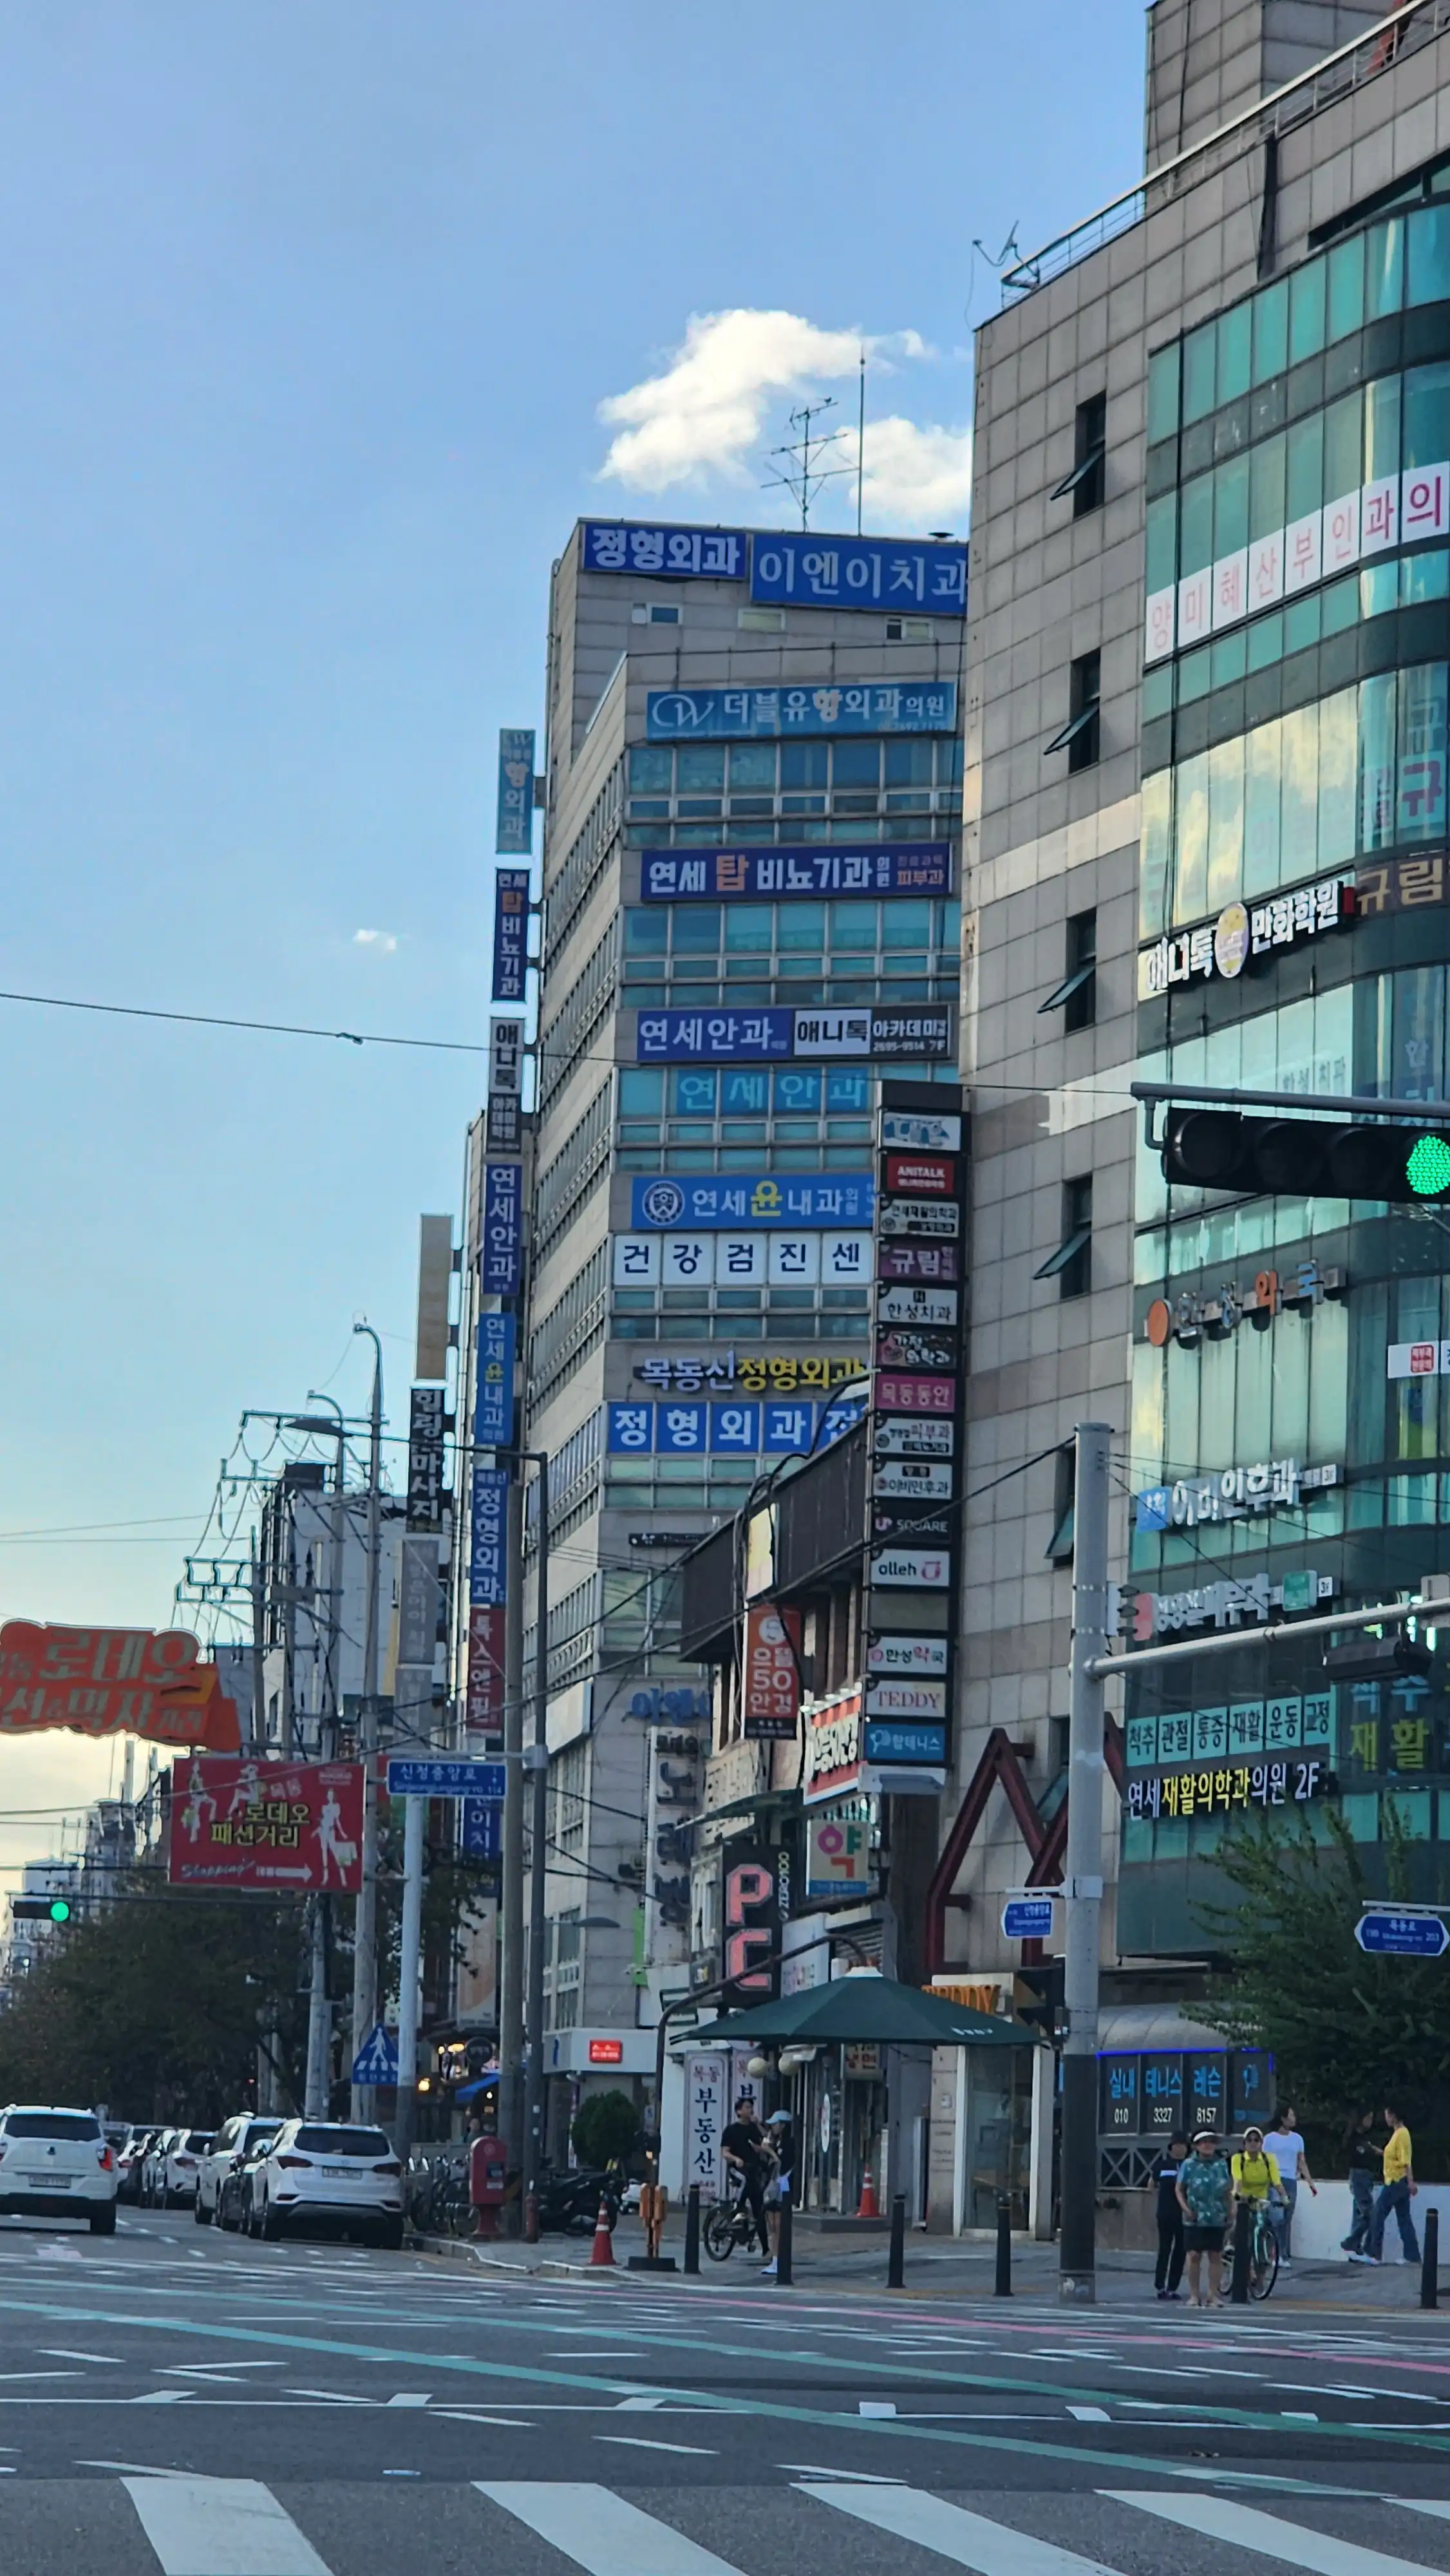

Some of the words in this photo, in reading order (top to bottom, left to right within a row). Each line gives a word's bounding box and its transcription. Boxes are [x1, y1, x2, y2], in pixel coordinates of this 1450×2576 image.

[592, 529, 740, 575] 정형외과
[650, 861, 706, 893] 연세
[717, 855, 749, 891] 탑
[757, 857, 872, 891] 비뇨기과
[897, 869, 944, 886] 피부과
[1357, 858, 1443, 917] 규림
[1251, 877, 1339, 954] 만화학원
[640, 1017, 773, 1051] 연세안과
[797, 1019, 868, 1043] 애니톡
[873, 1019, 937, 1038] 아카데미
[679, 1074, 865, 1123] 연세안과
[898, 1166, 945, 1178] ANITALK
[787, 1188, 842, 1215] 내과
[488, 1168, 517, 1282] 연세안과
[623, 1244, 860, 1274] 건강검진센
[889, 1249, 940, 1275] 규림
[737, 1357, 865, 1390] 정형외과
[881, 1383, 950, 1406] 목동동안
[614, 1410, 806, 1446] 정형외과
[411, 1452, 440, 1520] 마사지
[897, 1519, 948, 1532] SQUARE
[473, 1488, 501, 1603] 정형외과
[879, 1562, 917, 1576] olleh
[39, 1631, 194, 1683] 로데오
[753, 1669, 791, 1690] 50
[749, 1693, 791, 1714] 안경
[875, 1691, 940, 1708] TEDDY
[1162, 1719, 1188, 1753] 관절
[1270, 1705, 1298, 1739] 운동
[1128, 1763, 1286, 1821] 연세재활의학과의원
[1295, 1762, 1319, 1799] 2F
[245, 1801, 310, 1825] 로데오
[211, 1822, 300, 1848] 패션거리
[726, 1864, 773, 1992] PC
[1109, 2067, 1135, 2099] 실내
[1145, 2066, 1182, 2098] 테니스
[1194, 2066, 1221, 2097] 레슨
[694, 2087, 717, 2174] 부동산
[1115, 2108, 1129, 2123] 010
[1153, 2107, 1172, 2123] 3327
[1196, 2107, 1217, 2123] 8157
